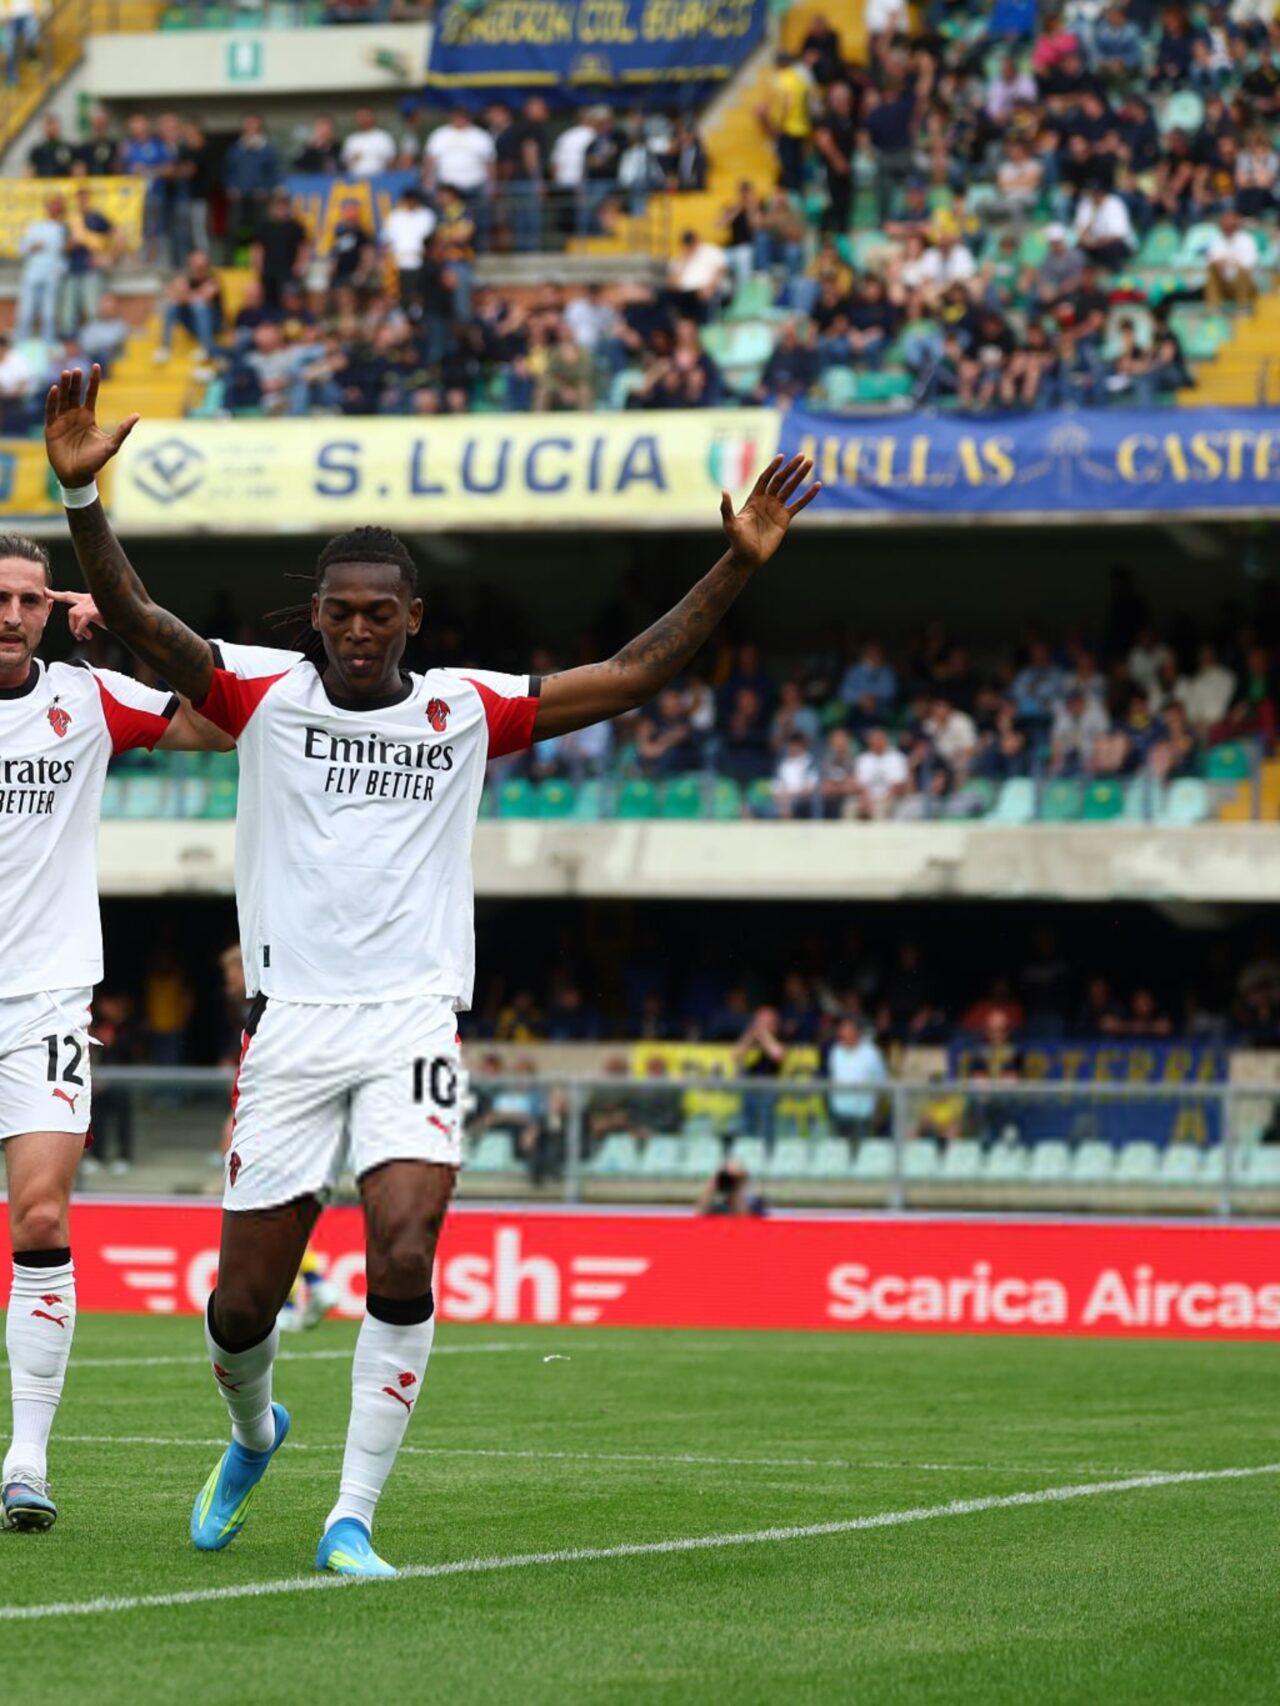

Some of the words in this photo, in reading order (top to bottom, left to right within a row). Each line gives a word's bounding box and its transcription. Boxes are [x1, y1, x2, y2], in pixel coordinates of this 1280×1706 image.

[305, 726, 454, 771] Emirates
[324, 766, 360, 794] FLY
[365, 769, 434, 801] BETTER
[45, 1034, 84, 1086] 12
[412, 1056, 457, 1109] 10
[828, 1264, 1068, 1322] Scarica
